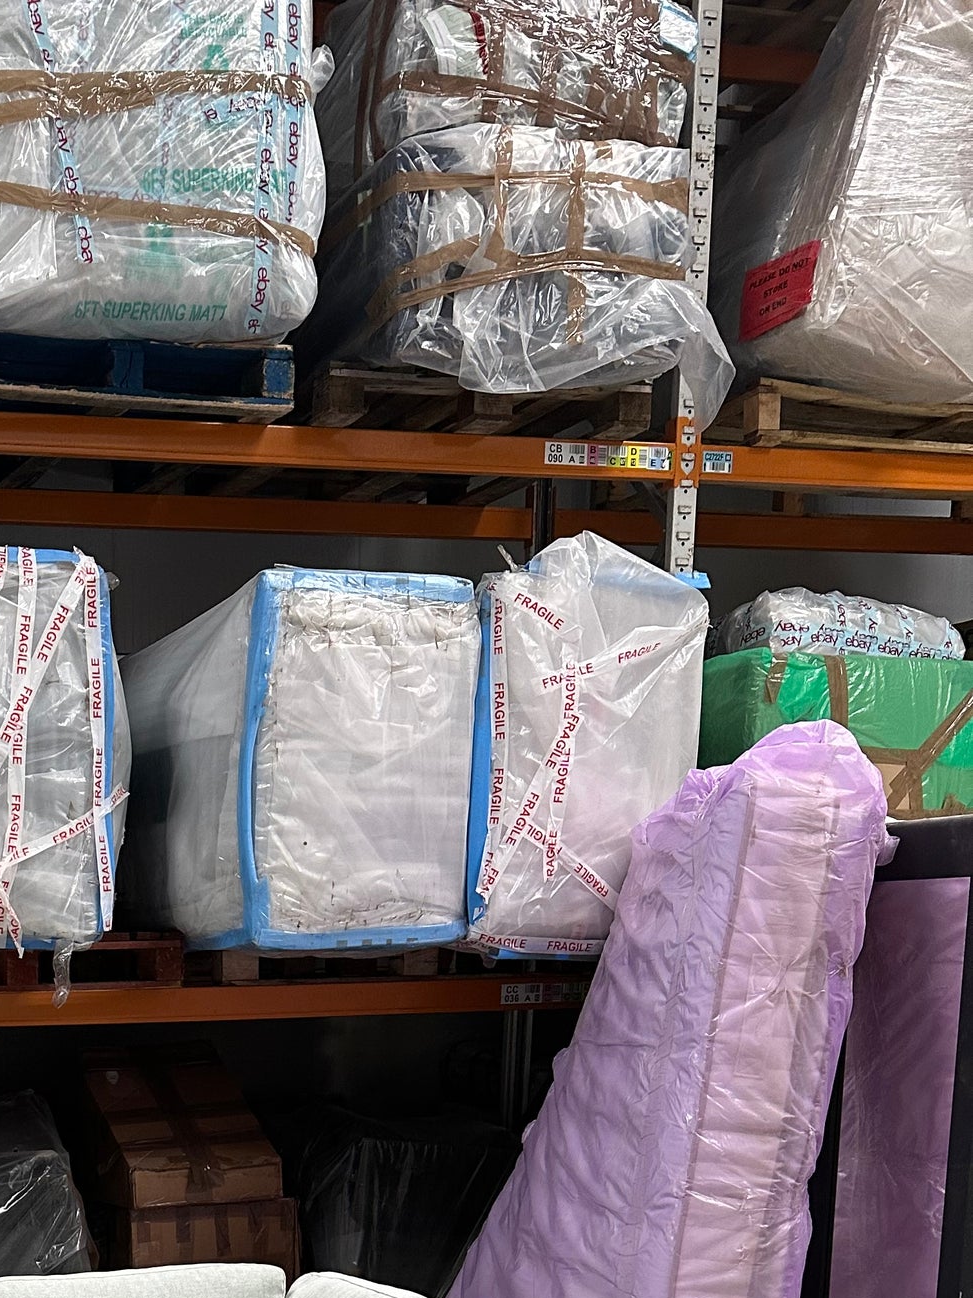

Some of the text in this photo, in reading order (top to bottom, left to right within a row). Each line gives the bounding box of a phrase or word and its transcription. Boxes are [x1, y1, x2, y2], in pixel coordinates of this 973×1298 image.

[287, 2, 301, 50] ebay
[287, 122, 301, 168] ebay
[172, 168, 256, 193] SUPERKING
[258, 149, 274, 195] ebay
[251, 267, 270, 313] ebay
[749, 257, 811, 290] PLEASE DO NOT
[763, 280, 789, 298] STORE
[73, 302, 227, 321] 6FT SUPERKING MATT
[759, 297, 787, 316] ON END
[547, 445, 657, 467] 090 A B C D E
[549, 444, 563, 453] CB
[86, 567, 98, 628] FRAGILE
[514, 592, 565, 630] FRAGILE
[16, 614, 31, 675] FRAGILE
[37, 604, 69, 663] FRAGILE
[617, 642, 661, 664] FRAGILE
[811, 631, 838, 646] ebay
[846, 636, 872, 652] ebay
[878, 642, 903, 657] ebay
[90, 658, 102, 719] FRAGILE
[542, 663, 594, 690] FRALE
[564, 663, 576, 719] FRAGILE
[0, 686, 33, 743] FRAGILE
[494, 682, 505, 740] FRAGILE
[545, 714, 580, 769] FRAGILE
[94, 748, 103, 807] FRAGILE
[490, 768, 504, 825] FRAGILE
[553, 748, 571, 803] FRAGILE
[8, 795, 21, 853] FRAGILE
[505, 792, 540, 846] FRAGILE
[99, 835, 112, 892] FRAGILE
[574, 862, 609, 898] FRAGILE
[479, 933, 527, 949] FRAGILE
[547, 941, 593, 952] FRAGILE
[506, 986, 519, 994] CC
